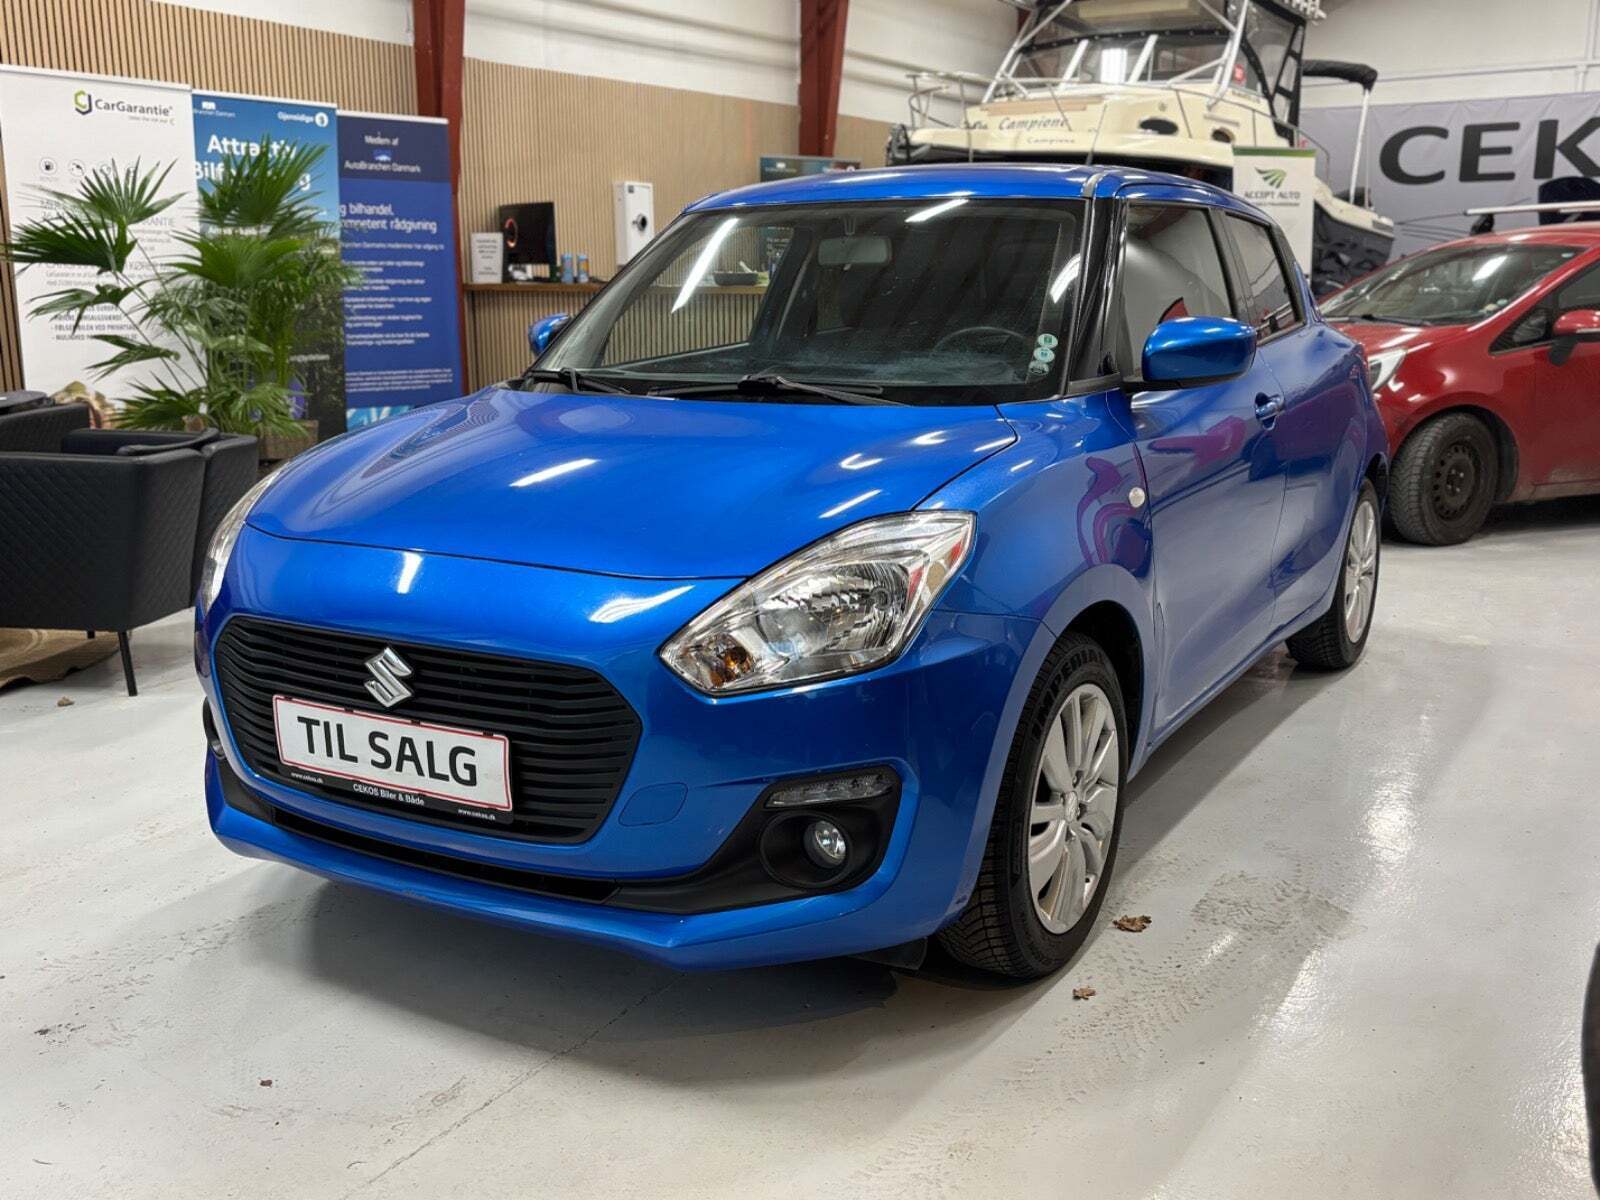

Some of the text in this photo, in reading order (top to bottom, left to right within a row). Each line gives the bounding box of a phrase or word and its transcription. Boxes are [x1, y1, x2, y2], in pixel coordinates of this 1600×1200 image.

[206, 134, 297, 160] Attrativ
[1379, 117, 1600, 186] CEK
[297, 716, 477, 787] TIL SALG
[353, 783, 379, 797] CEKOS
[380, 789, 397, 801] Biler
[405, 794, 425, 806] Både
